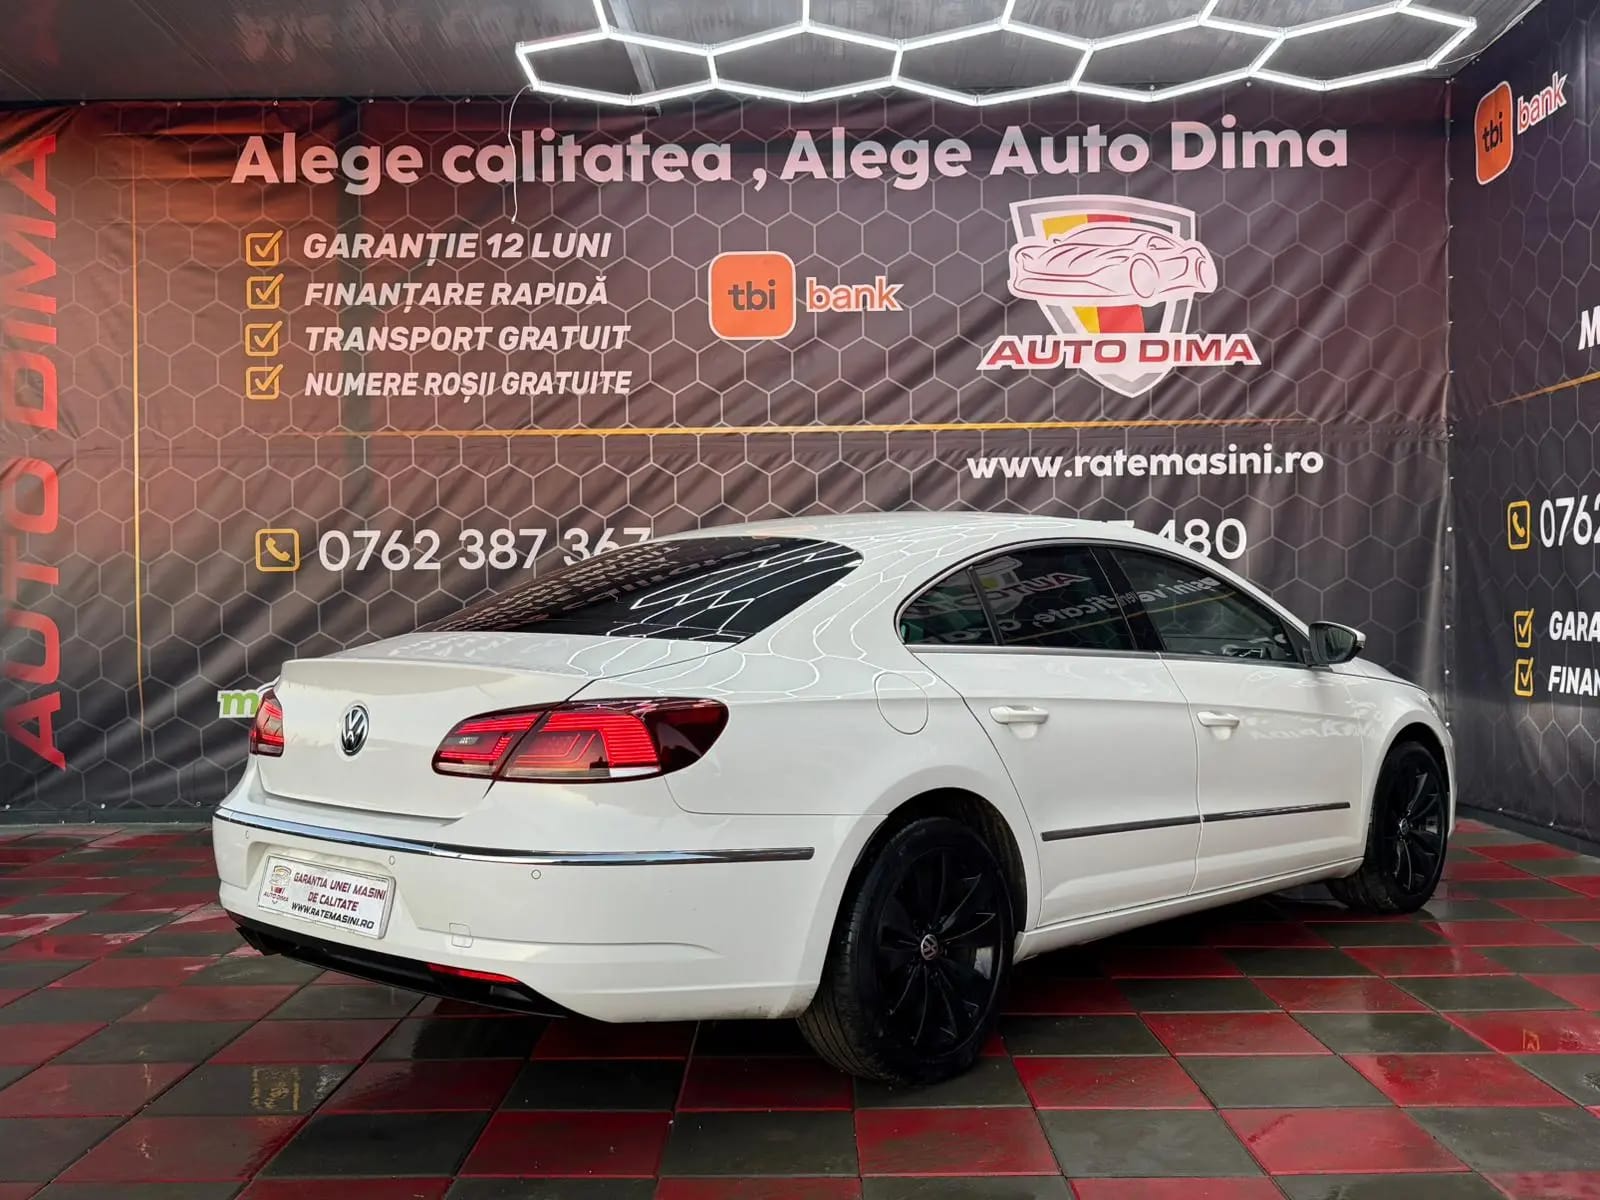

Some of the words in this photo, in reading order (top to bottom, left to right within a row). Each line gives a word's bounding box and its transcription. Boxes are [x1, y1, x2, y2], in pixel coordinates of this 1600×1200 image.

[1481, 111, 1504, 152] tbi
[1517, 72, 1567, 134] bank
[231, 130, 424, 196] Alege
[441, 127, 733, 183] calitatea
[780, 125, 972, 191] Alege
[990, 123, 1150, 177] Auto
[1170, 114, 1349, 170] Dima
[486, 232, 524, 258] 12
[531, 232, 612, 258] LUNI
[0, 133, 58, 431] DIMA
[490, 275, 609, 306] RAPIDĂ
[728, 279, 776, 311] tbi
[806, 276, 904, 313] bank
[305, 326, 493, 352] TRANSPORT
[499, 325, 632, 351] GRATUIT
[986, 340, 1128, 366] AUTO
[1138, 338, 1254, 363] DIMA
[304, 372, 419, 397] NUMERE
[501, 371, 633, 397] GRATUITE
[966, 444, 1325, 480] www.ratemasini.ro
[318, 528, 441, 572] 0762
[457, 528, 548, 571] 387
[2, 456, 67, 770] AUTO
[293, 872, 329, 889] GARANTIA
[330, 879, 352, 894] UNEI
[353, 884, 386, 900] MASINI
[307, 891, 319, 903] DE
[319, 893, 359, 912] CALITATE
[291, 901, 375, 930] WWW.RATEMASINI.RO
